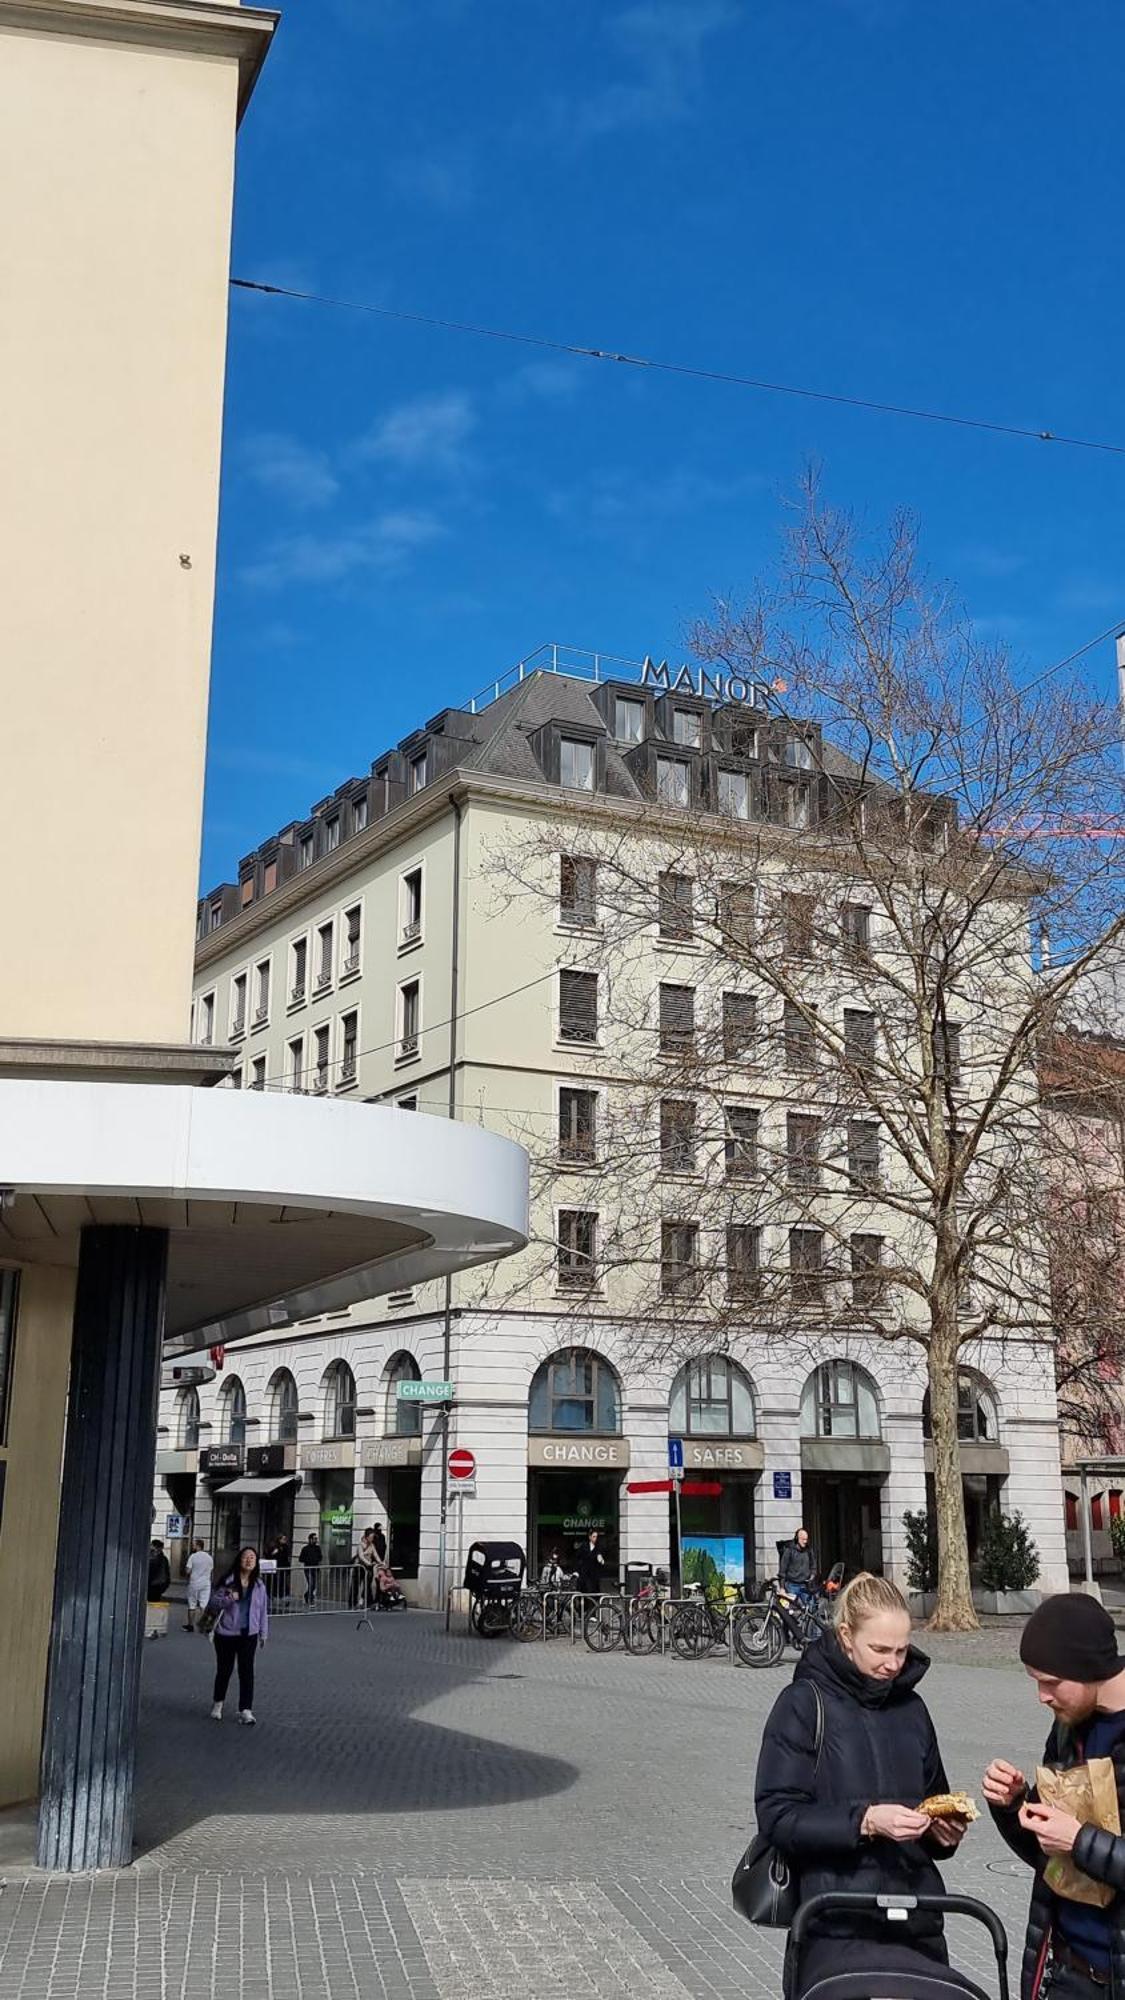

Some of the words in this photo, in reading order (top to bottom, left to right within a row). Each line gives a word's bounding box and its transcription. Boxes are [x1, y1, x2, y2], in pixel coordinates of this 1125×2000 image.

[641, 655, 771, 710] MANOR
[402, 1385, 450, 1396] CHANGE
[543, 1445, 618, 1462] CHANGE
[693, 1448, 743, 1464] SAFES
[563, 1518, 606, 1529] CHANGE
